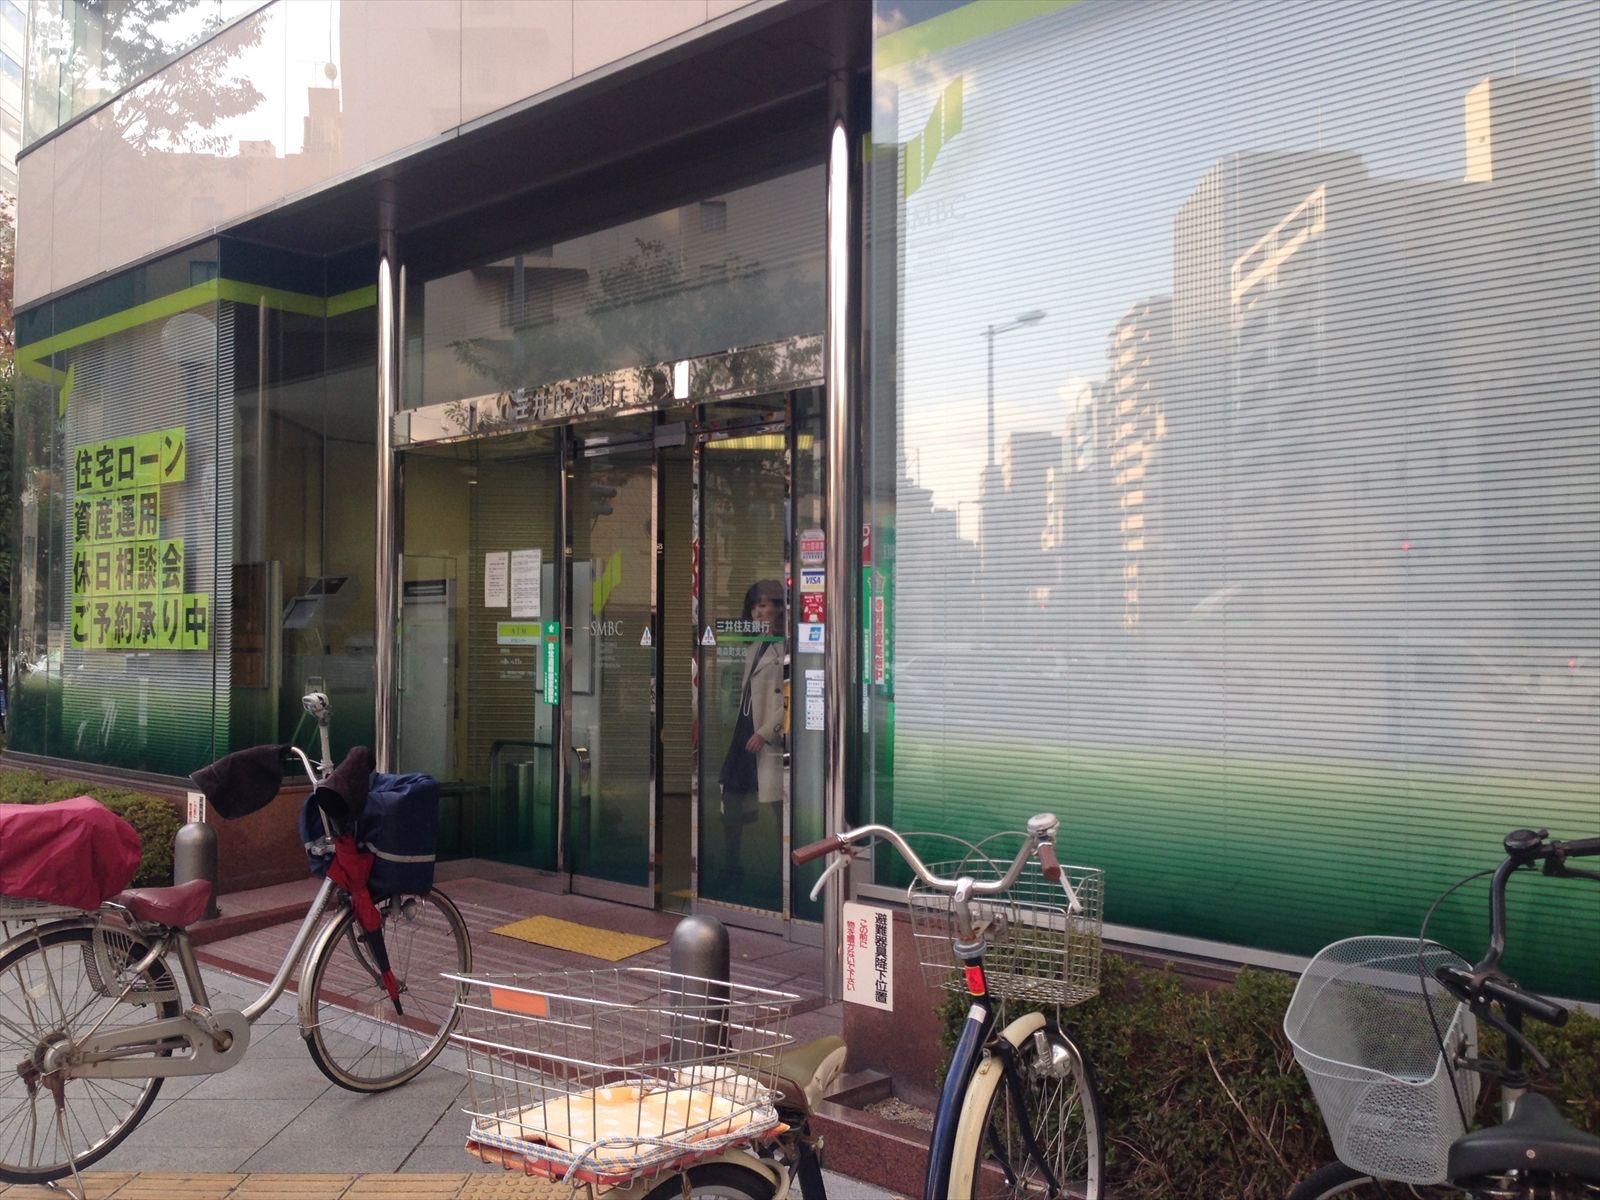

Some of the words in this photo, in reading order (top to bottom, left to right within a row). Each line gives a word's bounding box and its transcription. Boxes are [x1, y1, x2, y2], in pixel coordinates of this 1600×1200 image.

[75, 436, 184, 491] 住宅ローン
[74, 492, 157, 542] 資産運用
[73, 543, 182, 593] 休日相談会
[805, 576, 821, 585] VISA
[73, 599, 207, 645] ご予約承り中
[590, 620, 624, 636] SMBC
[716, 620, 770, 633] 三井住友銀行
[874, 912, 888, 1004] 避難器具降下位置
